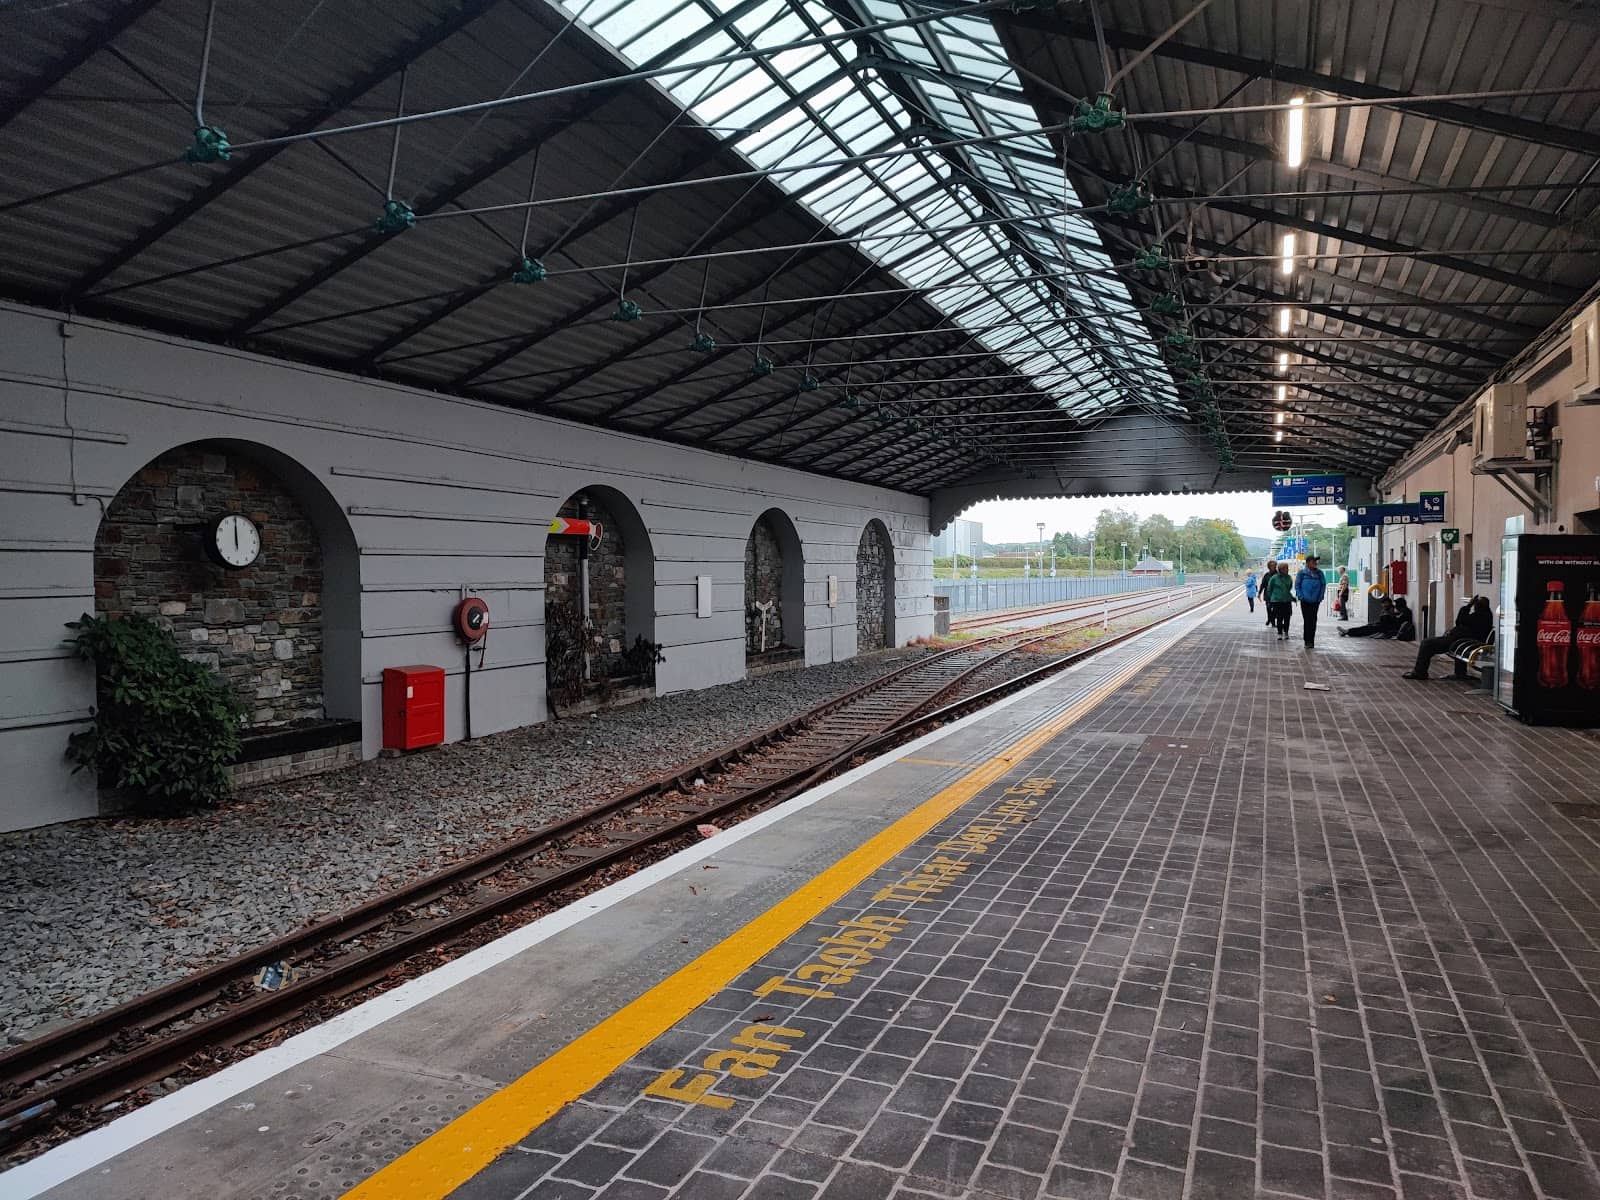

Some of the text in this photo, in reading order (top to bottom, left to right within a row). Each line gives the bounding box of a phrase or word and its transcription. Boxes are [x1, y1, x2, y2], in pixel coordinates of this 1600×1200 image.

[643, 1025, 806, 1110] Fan
[753, 914, 909, 999] Taobh
[871, 856, 972, 902] Thiar
[1004, 777, 1057, 796] Seo
